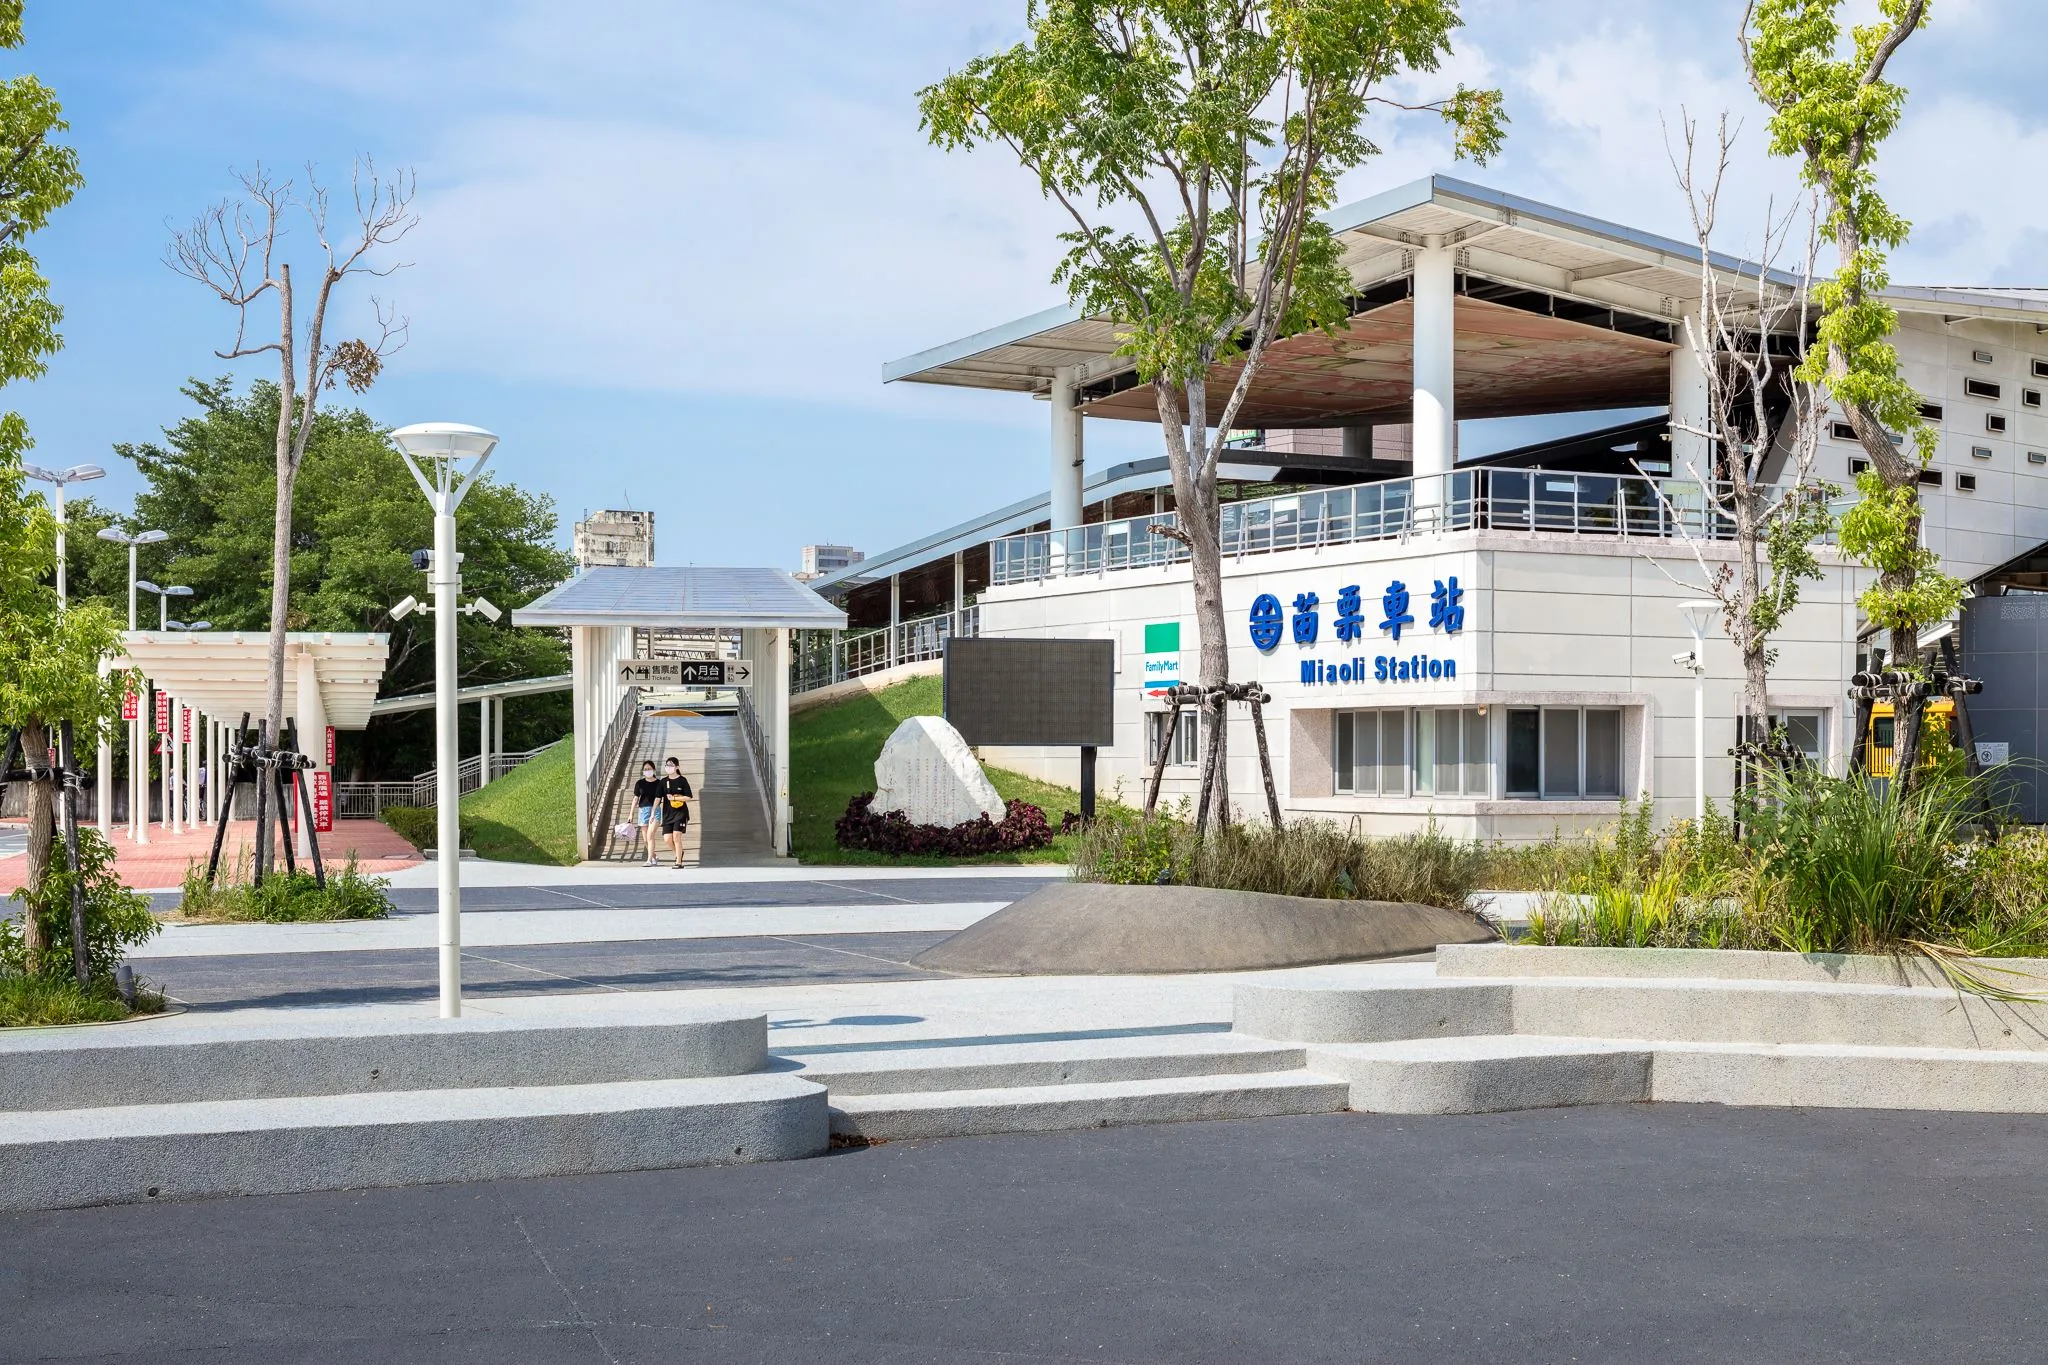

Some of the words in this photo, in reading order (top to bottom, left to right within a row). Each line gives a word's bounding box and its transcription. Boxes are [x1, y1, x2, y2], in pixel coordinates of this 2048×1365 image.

[1292, 576, 1465, 644] 苗栗車站
[652, 665, 678, 674] 售票處
[698, 665, 719, 676] 月台
[1145, 660, 1179, 673] FamilyMart
[1301, 657, 1366, 684] Miaoli
[1374, 654, 1456, 681] Station
